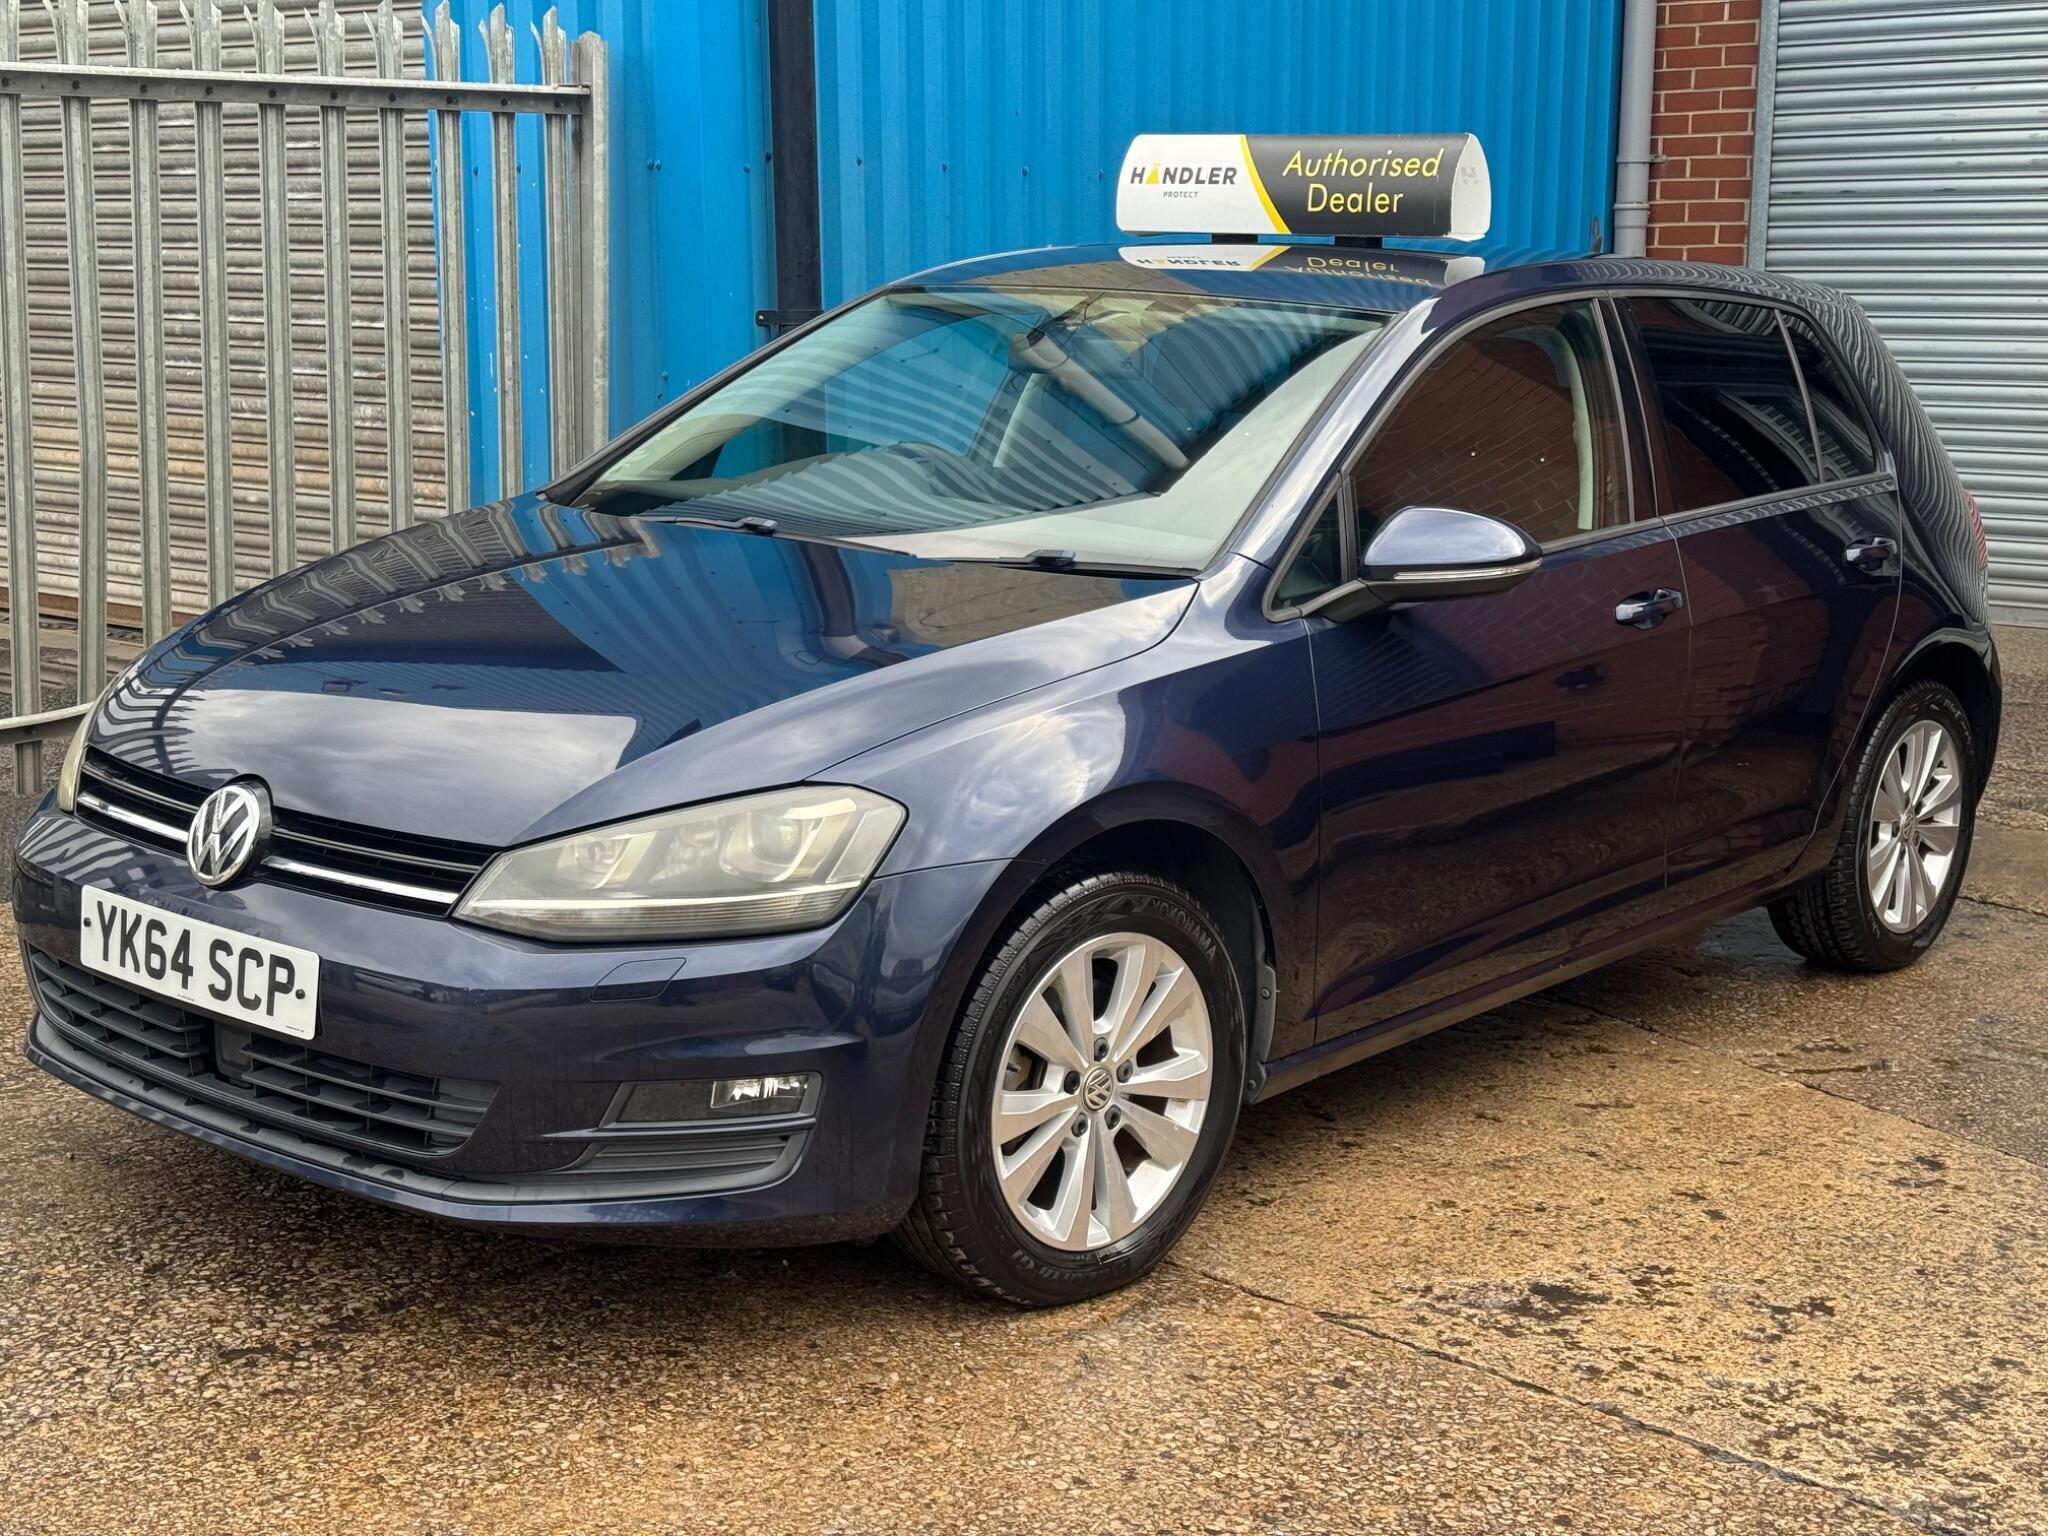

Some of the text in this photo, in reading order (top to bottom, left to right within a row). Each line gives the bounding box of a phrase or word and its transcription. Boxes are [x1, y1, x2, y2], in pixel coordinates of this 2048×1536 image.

[1282, 148, 1445, 177] Authorised
[1162, 191, 1199, 199] PROTECT
[1307, 182, 1404, 213] Dealer
[1151, 899, 1217, 961] YOKOHAMA
[96, 899, 297, 1017] YK64 SCP
